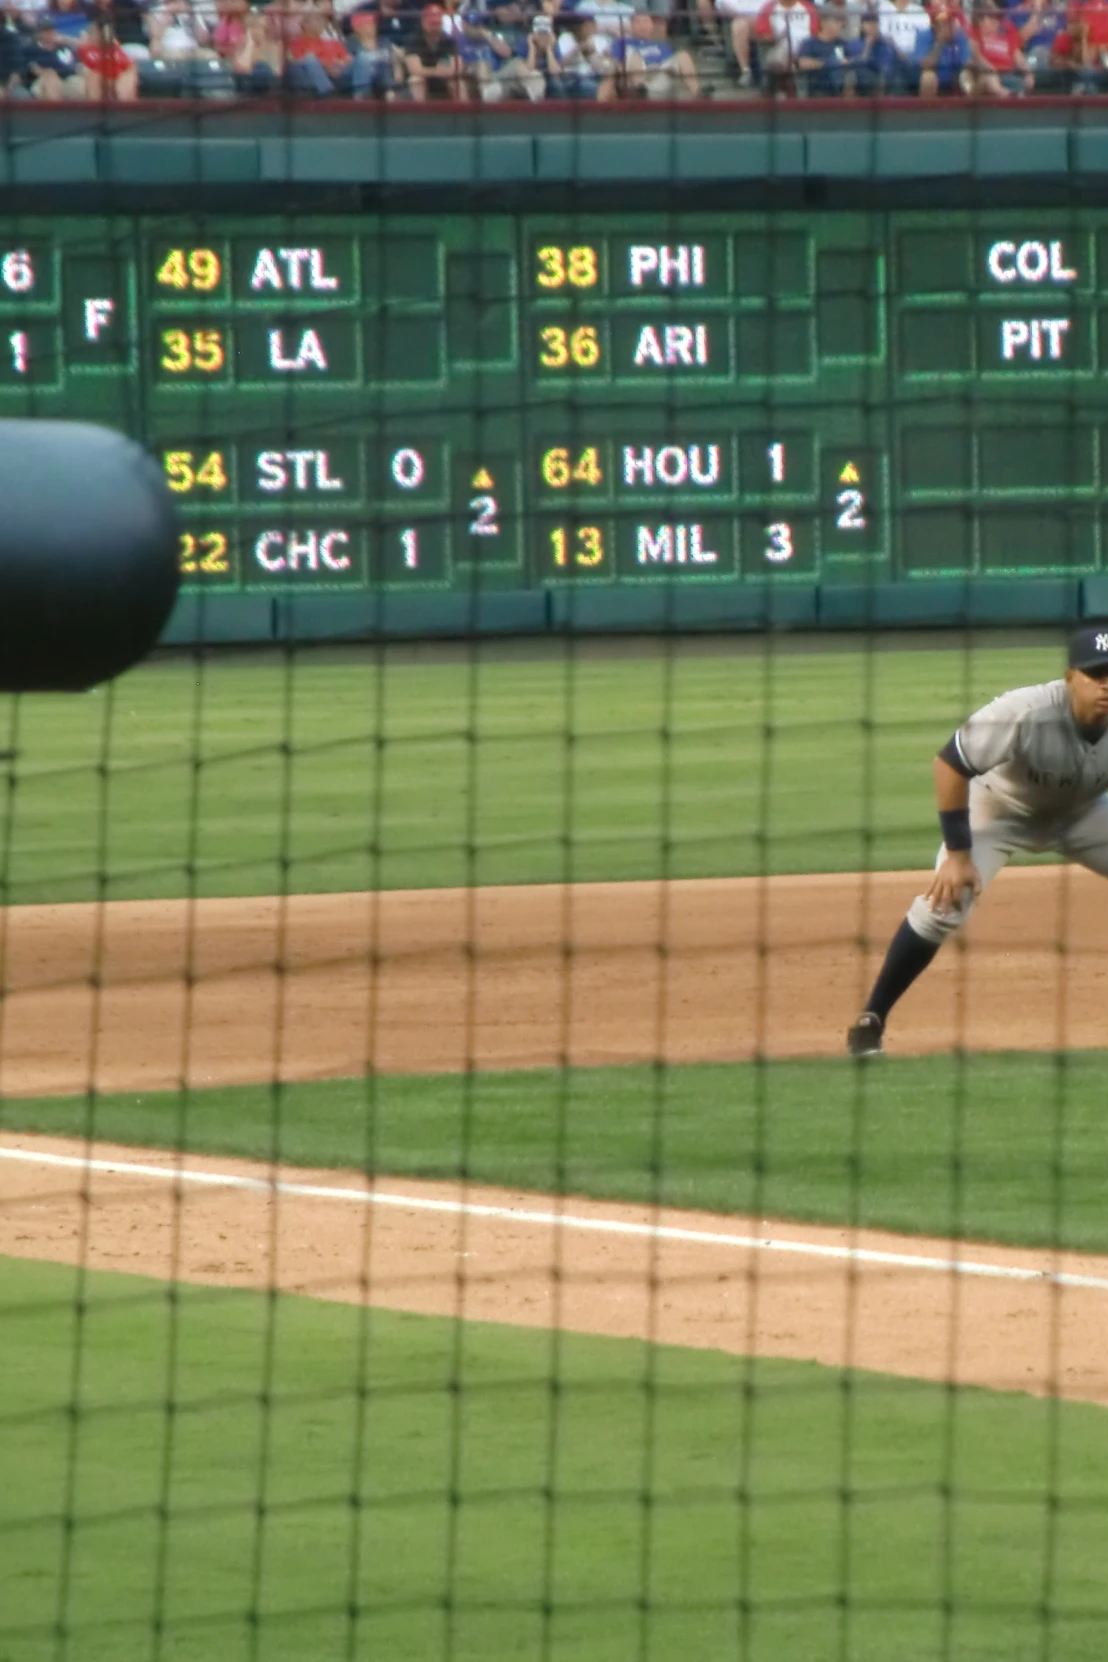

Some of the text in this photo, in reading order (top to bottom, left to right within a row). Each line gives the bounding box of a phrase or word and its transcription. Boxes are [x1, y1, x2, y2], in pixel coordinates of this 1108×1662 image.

[157, 248, 339, 291] 49 ATL
[537, 245, 705, 289] 38 PHI
[988, 241, 1077, 283] COL
[84, 298, 114, 339] F
[1002, 319, 1071, 360] PIT
[10, 332, 27, 372] 1
[162, 329, 328, 372] 35 LA
[541, 324, 708, 368] 36 ARI
[166, 451, 228, 492] 54
[257, 450, 342, 490] STL
[543, 443, 785, 488] 64 HOU 1
[470, 496, 500, 535] 2
[837, 490, 866, 529] 2
[255, 531, 351, 572] CHC
[401, 529, 417, 568] 1
[551, 522, 794, 566] 13 MIL 3
